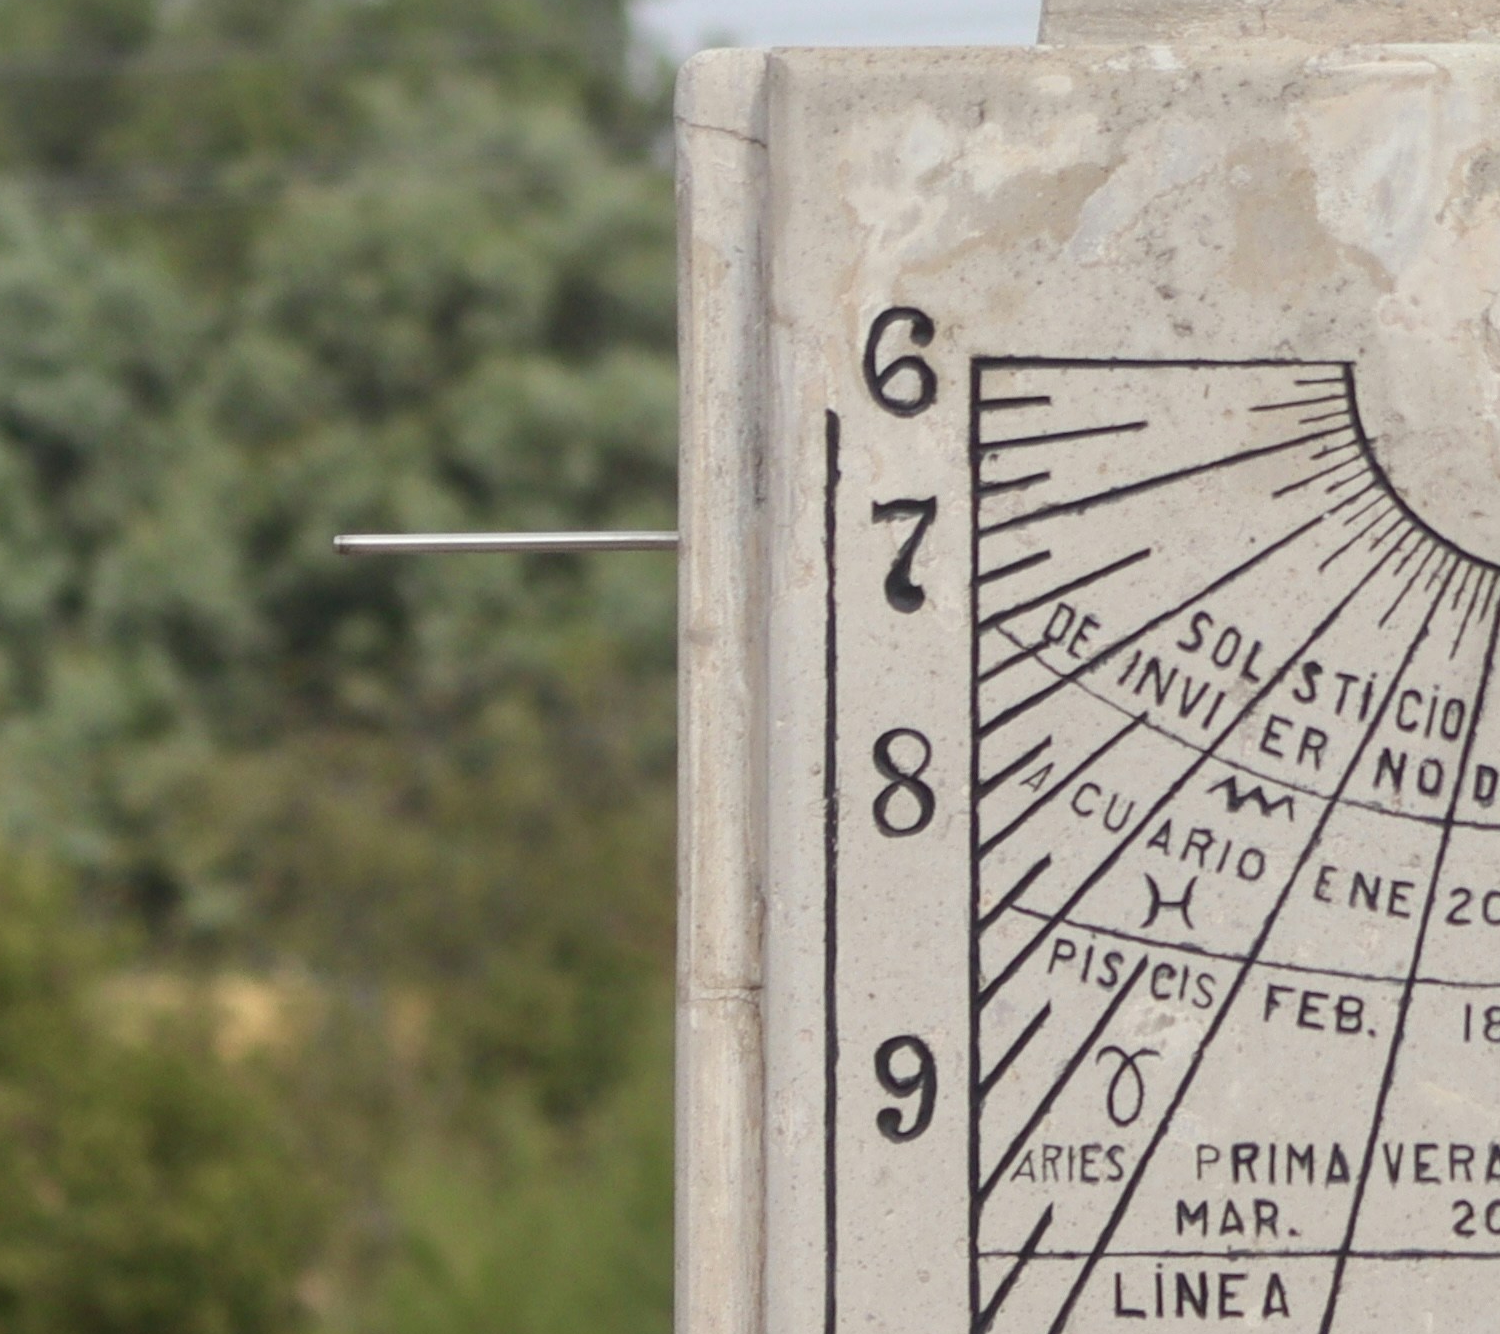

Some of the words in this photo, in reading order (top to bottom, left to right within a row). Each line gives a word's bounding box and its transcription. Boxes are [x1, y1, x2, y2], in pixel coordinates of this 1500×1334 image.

[863, 306, 938, 417] 6
[871, 495, 938, 614] 7
[1042, 602, 1102, 659] DE
[873, 727, 937, 838] 8
[1314, 864, 1417, 919] ENE
[1263, 985, 1377, 1038] FEB.
[874, 1035, 938, 1141] 9
[1011, 1143, 1126, 1183] ARIES
[1176, 1200, 1301, 1237] MAR.
